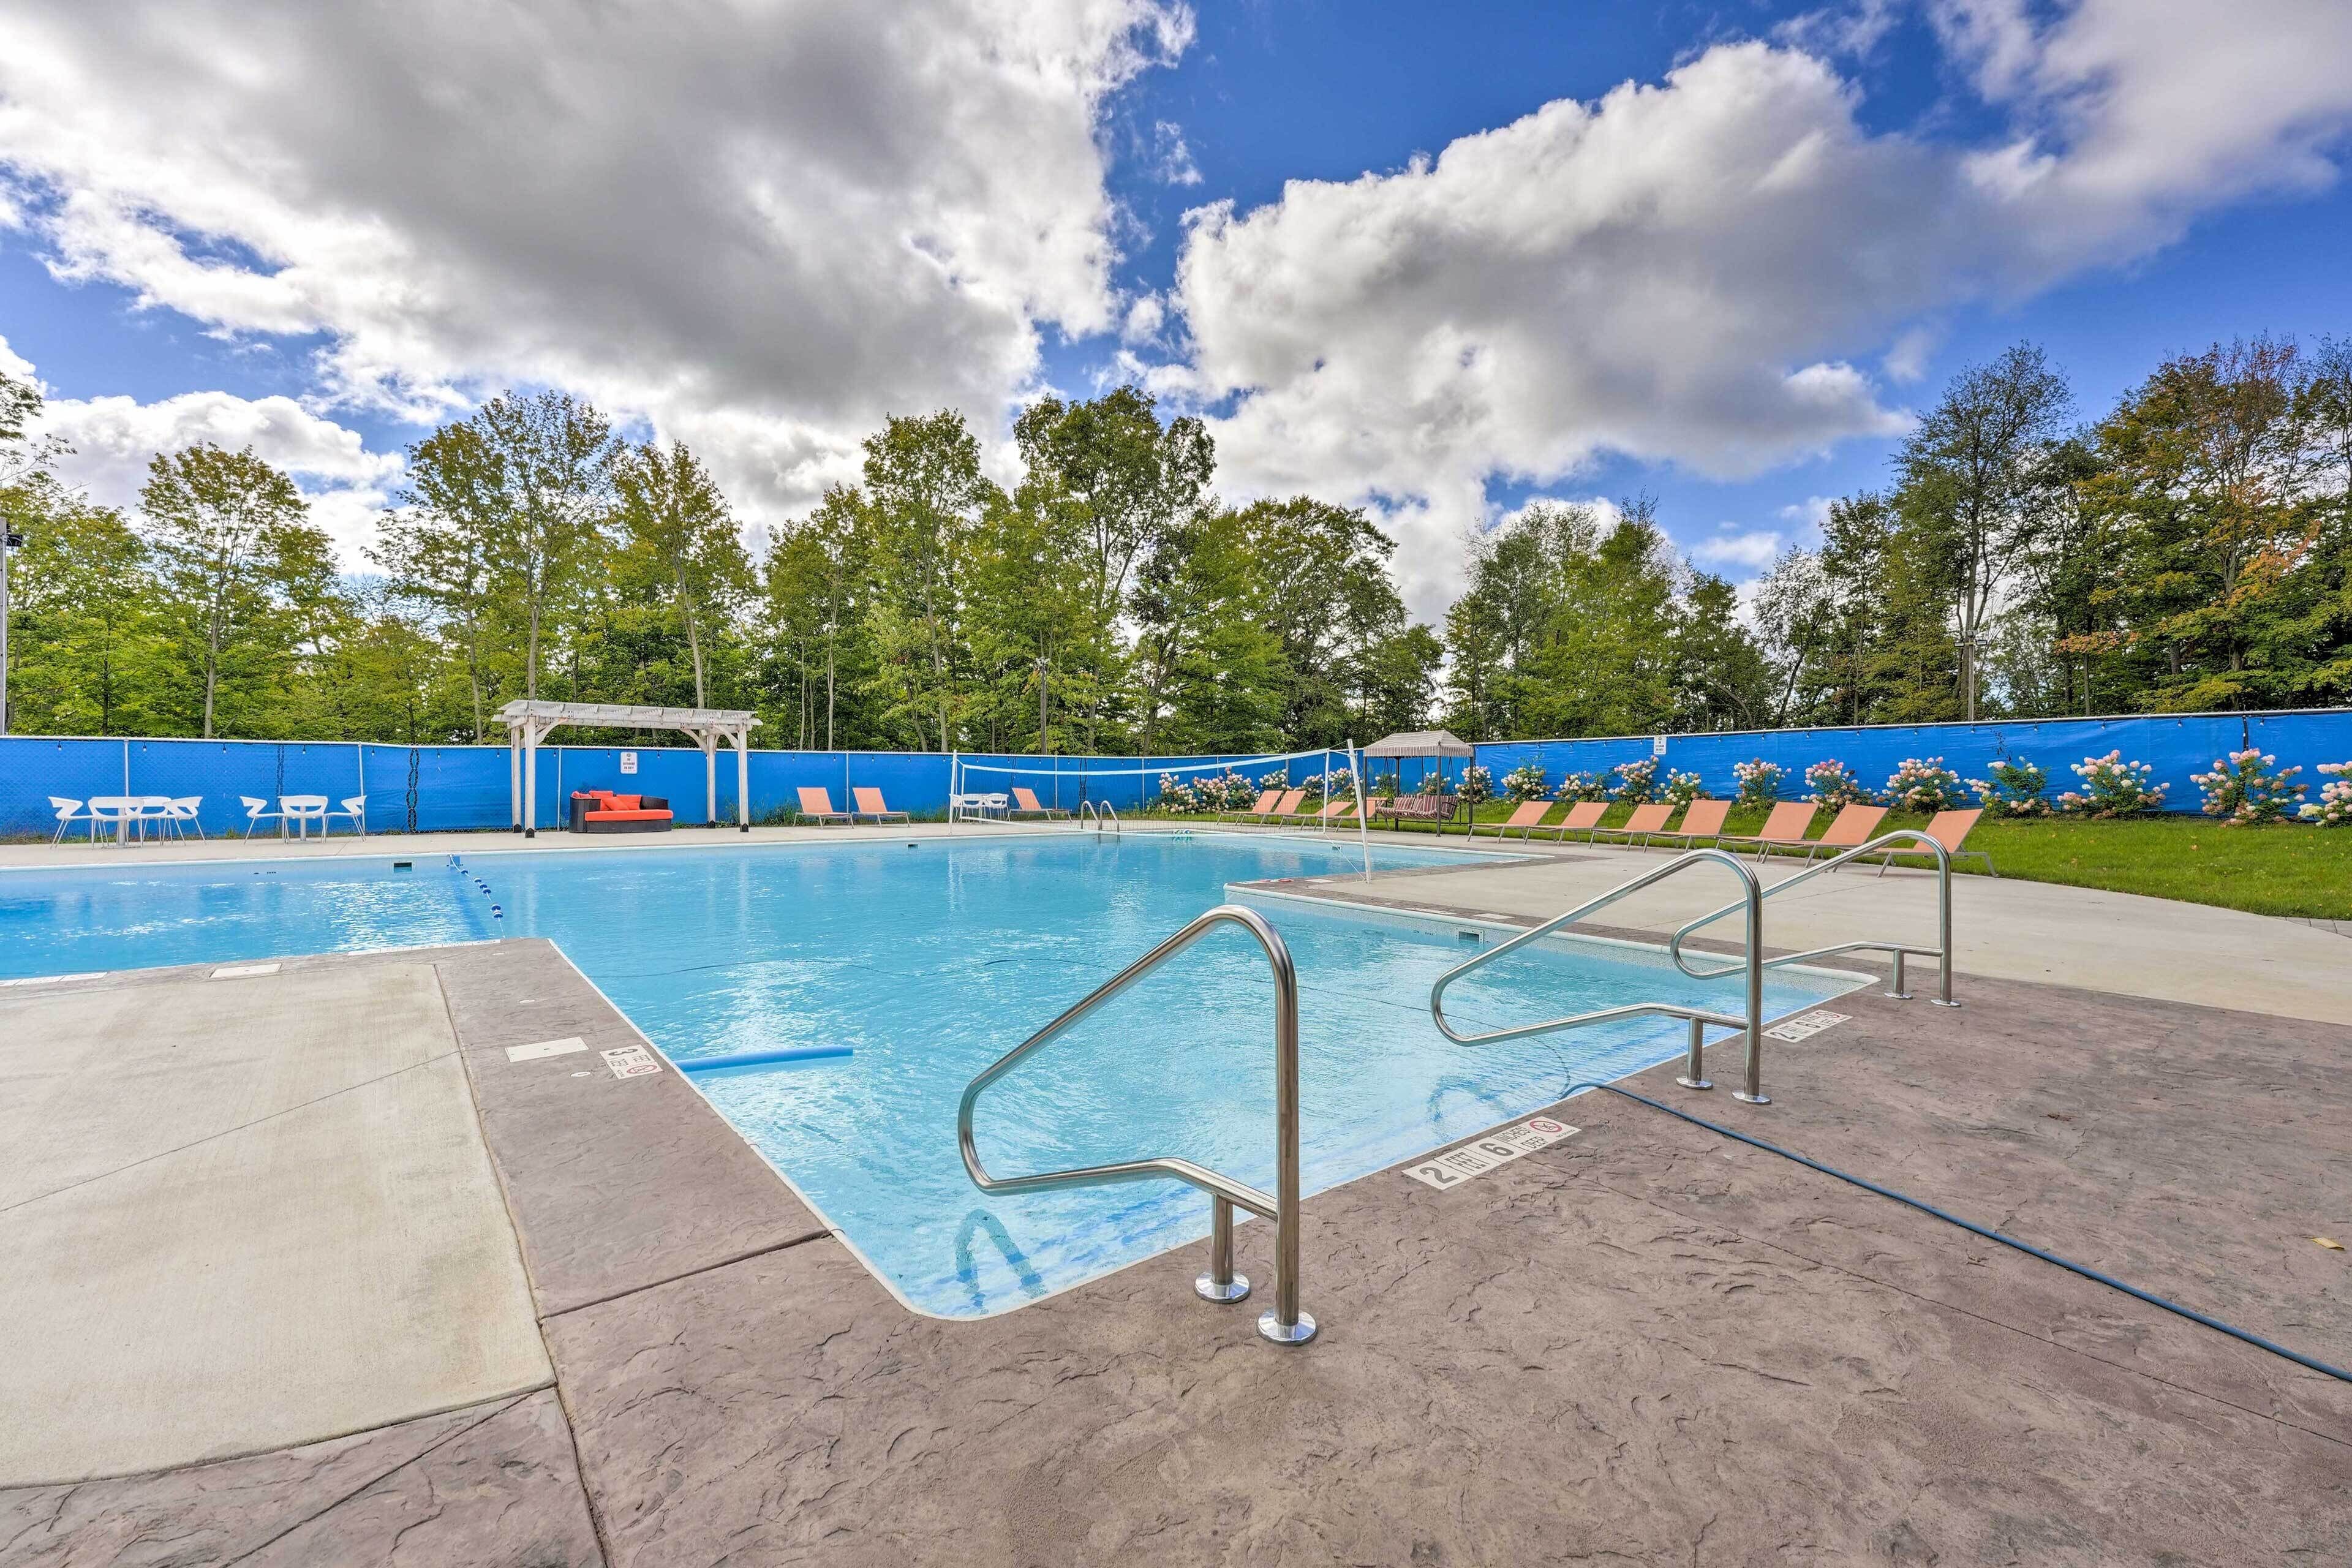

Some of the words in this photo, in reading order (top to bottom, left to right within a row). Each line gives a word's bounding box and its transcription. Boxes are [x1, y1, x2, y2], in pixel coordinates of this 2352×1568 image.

[1494, 1127, 1531, 1142] INCHES
[1479, 1143, 1514, 1156] 6
[1521, 1136, 1548, 1149] DEEP
[1444, 1152, 1490, 1171] FEET
[1419, 1167, 1458, 1183] 2
